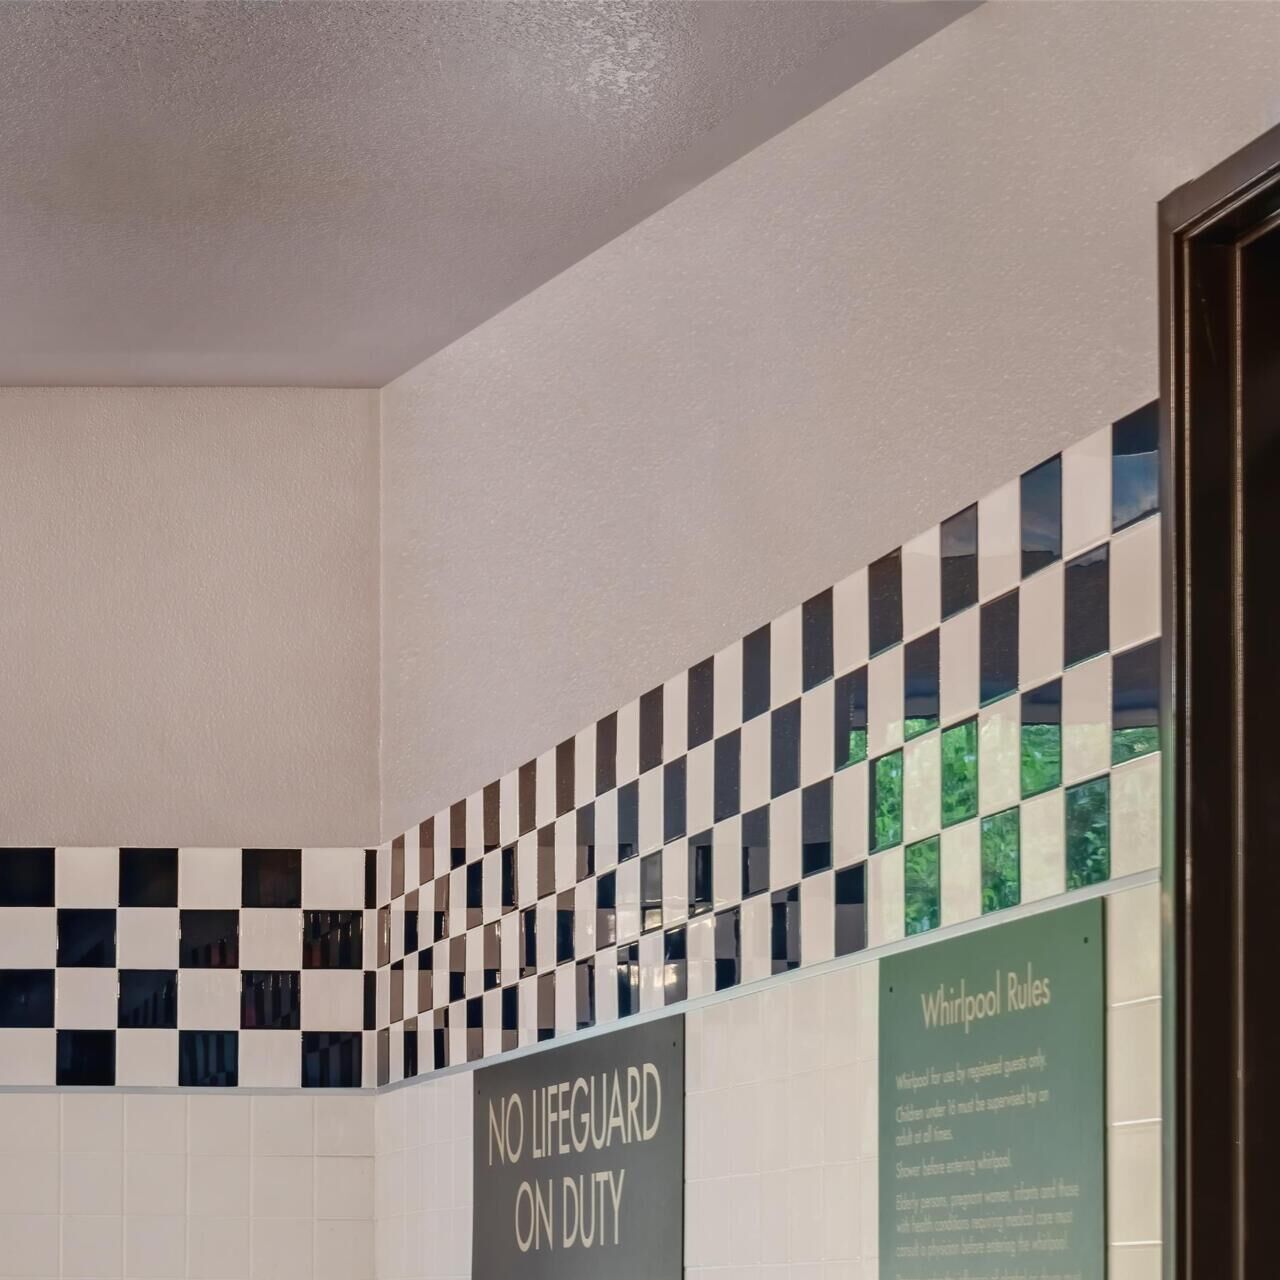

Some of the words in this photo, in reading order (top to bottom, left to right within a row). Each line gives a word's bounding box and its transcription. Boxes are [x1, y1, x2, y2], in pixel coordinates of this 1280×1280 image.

[921, 969, 1000, 1034] Whirlpool
[1008, 962, 1051, 1011] Rules
[489, 1093, 524, 1166] NO
[532, 1063, 662, 1158] LIFEGUARD
[515, 1180, 553, 1252] ON
[563, 1169, 624, 1248] DUTY
